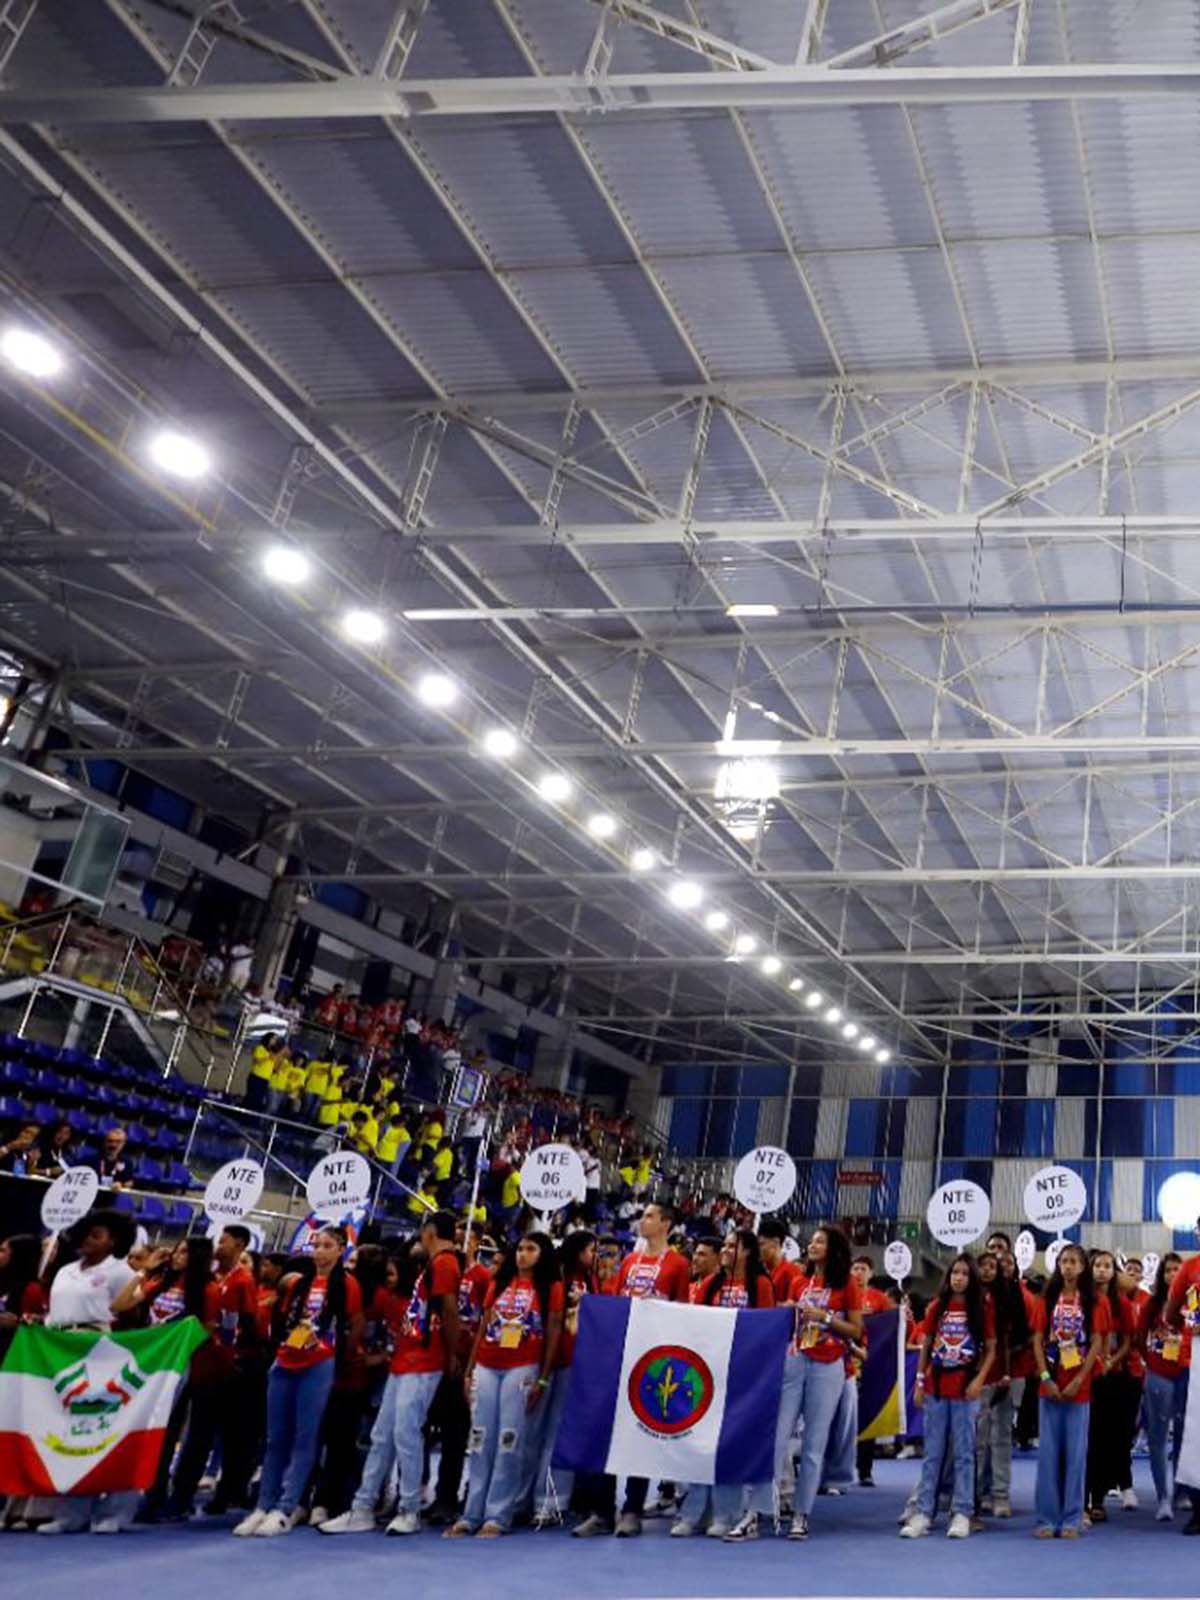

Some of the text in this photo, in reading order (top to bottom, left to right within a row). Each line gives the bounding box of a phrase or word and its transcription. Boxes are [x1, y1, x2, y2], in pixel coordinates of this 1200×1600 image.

[537, 1152, 570, 1165] NTE
[755, 1151, 785, 1167] NTE
[324, 1160, 355, 1176] NTE
[65, 1172, 92, 1186] NTE
[227, 1167, 257, 1184] NTE
[541, 1172, 559, 1185] 06
[756, 1171, 775, 1184] 07
[329, 1181, 346, 1194] 04
[1037, 1175, 1068, 1192] NTE
[224, 1188, 241, 1201] 03
[943, 1191, 974, 1204] NTE
[1046, 1198, 1064, 1209] 09
[949, 1211, 966, 1223] 08
